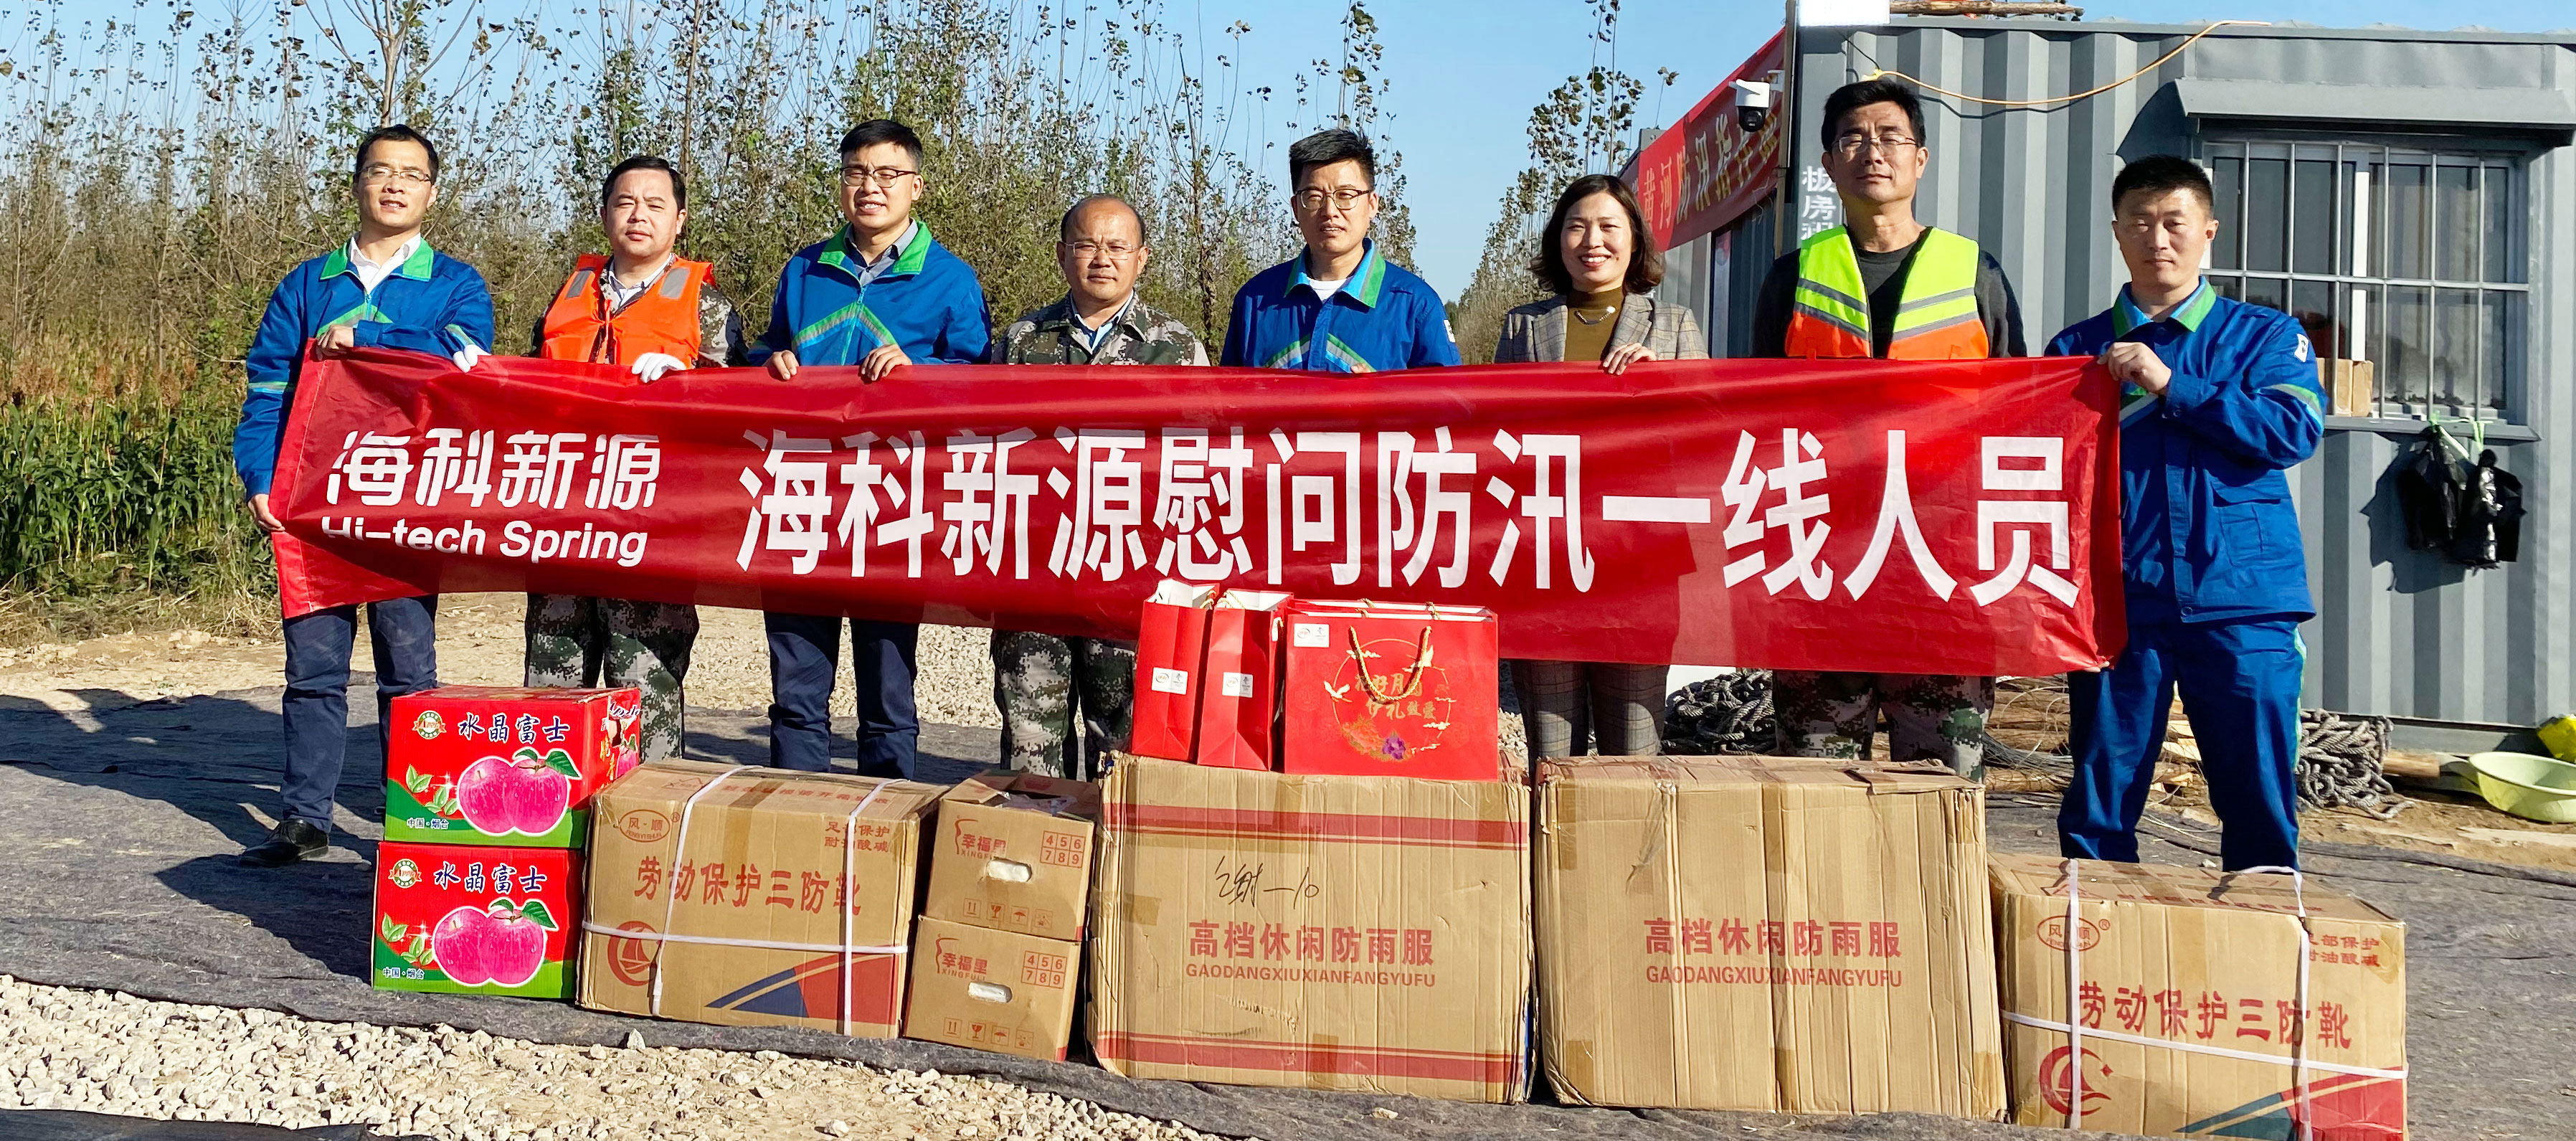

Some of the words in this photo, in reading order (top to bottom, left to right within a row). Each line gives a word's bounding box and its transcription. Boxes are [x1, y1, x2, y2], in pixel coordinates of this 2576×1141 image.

[326, 427, 660, 510] 海科新源
[736, 426, 2080, 610] 海科新源慰问防汛一线人员
[321, 516, 486, 556] Hi-tech
[499, 520, 648, 567] Spring
[458, 712, 571, 744] 水晶富士
[435, 862, 547, 894] 水晶富士
[635, 856, 861, 916] 劳动保护三防靴
[1189, 919, 1434, 967] 高档休闲防雨服
[1644, 917, 1902, 958] 高档休闲防雨服
[942, 952, 988, 975] 幸福里
[1186, 963, 1435, 988] GAODANGXIUXIANFANGYUFU
[1646, 966, 1903, 988] GAODANGXIUXIANFANGYUFU
[2078, 980, 2352, 1050] 劳动保护三防靴
